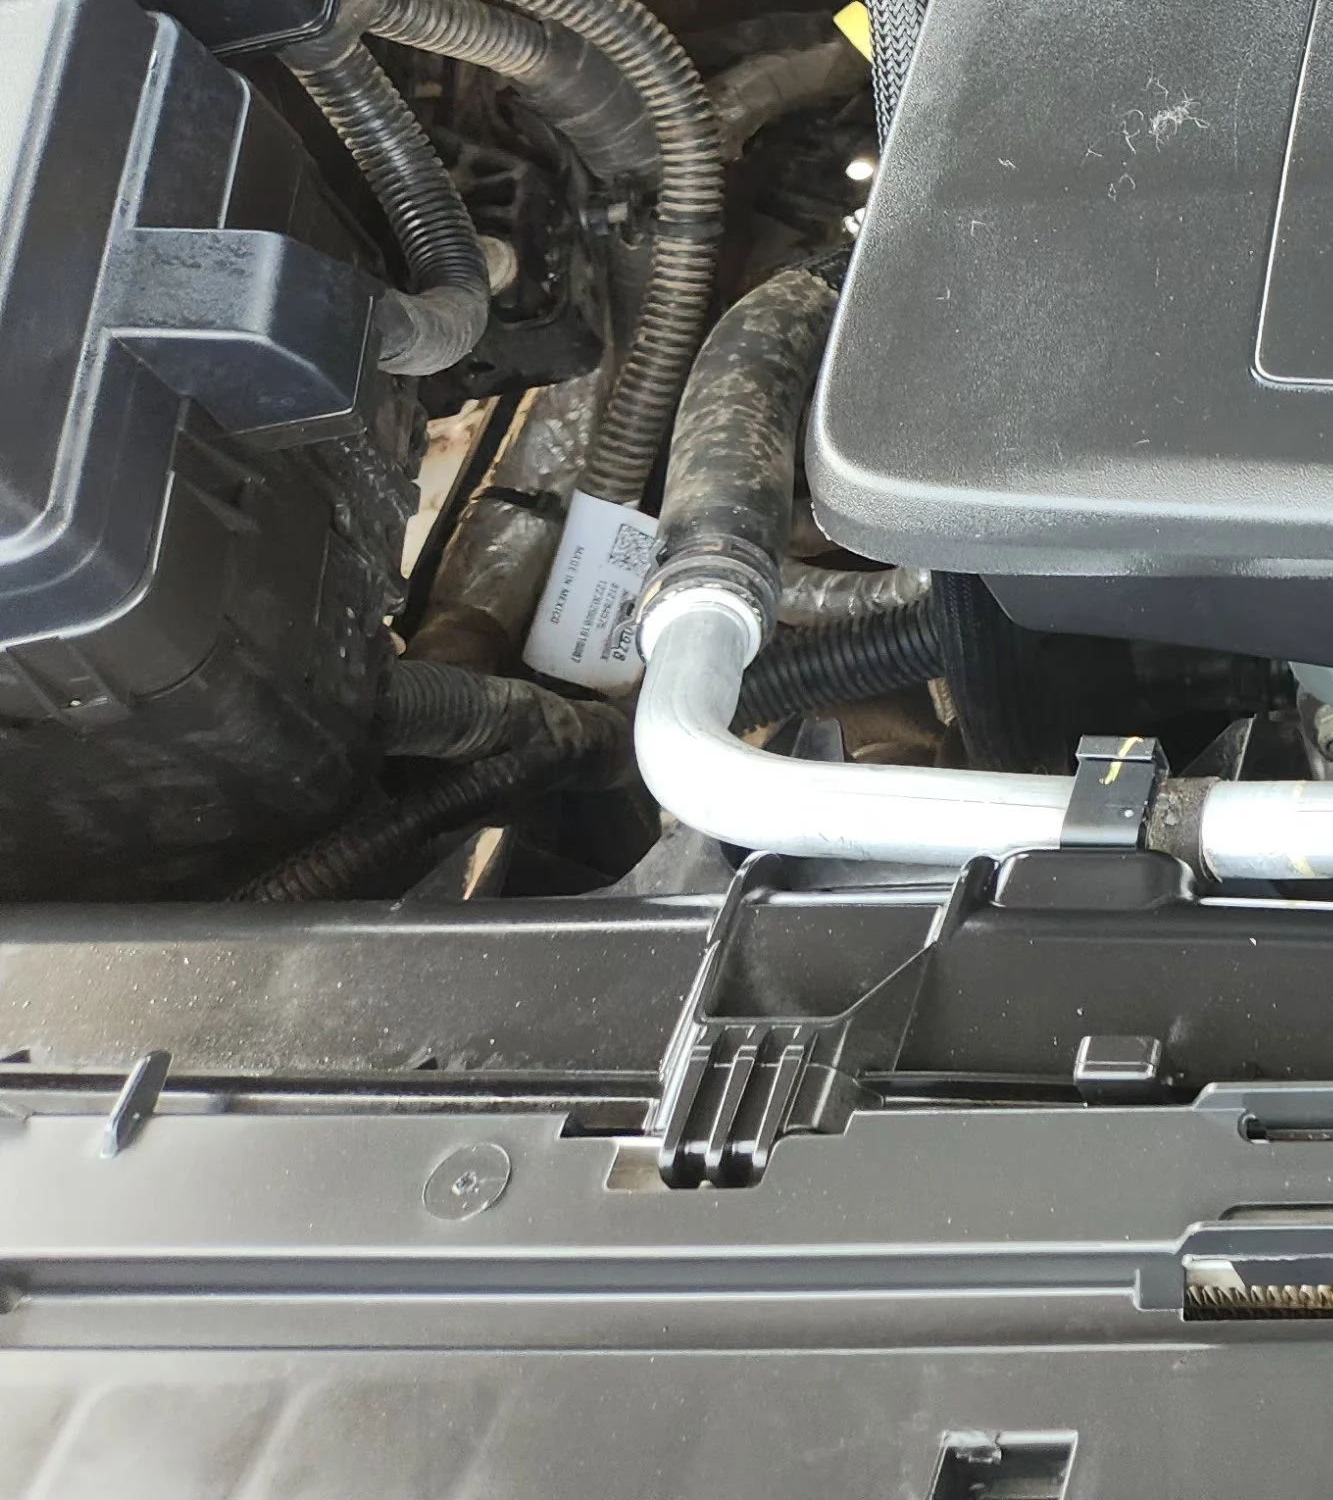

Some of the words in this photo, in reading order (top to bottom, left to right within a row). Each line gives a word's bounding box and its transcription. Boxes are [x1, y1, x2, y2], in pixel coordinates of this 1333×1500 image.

[568, 545, 586, 573] MADE
[563, 574, 576, 587] IN
[549, 588, 570, 625] MEXICO
